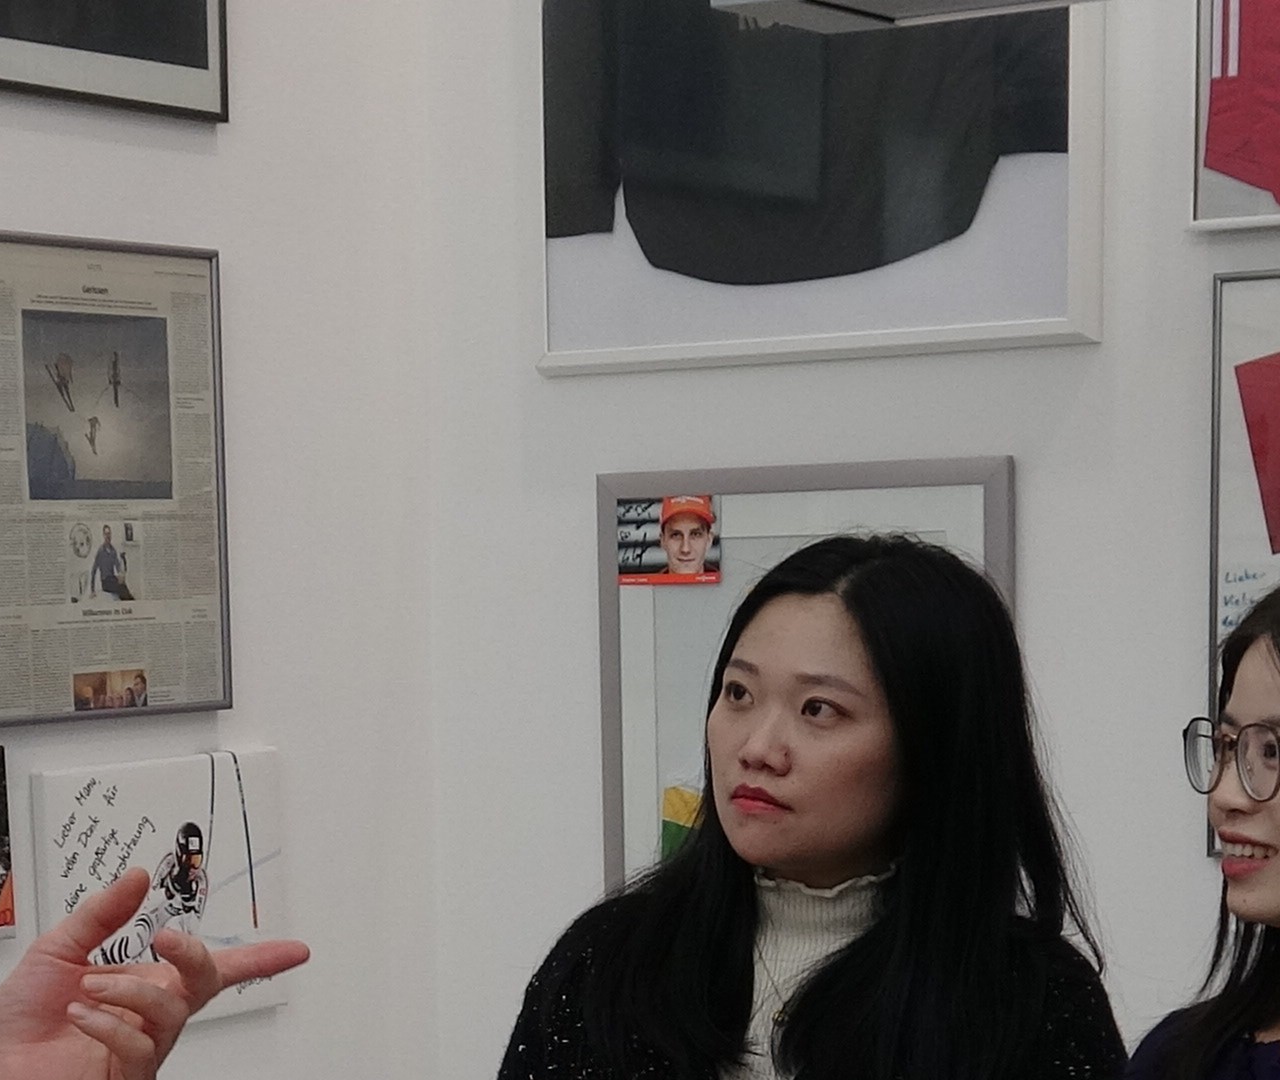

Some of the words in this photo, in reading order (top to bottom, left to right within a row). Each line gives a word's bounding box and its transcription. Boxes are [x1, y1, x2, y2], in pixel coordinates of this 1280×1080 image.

[53, 811, 77, 849] Lieber
[77, 814, 101, 849] Dank
[101, 784, 119, 808] für
